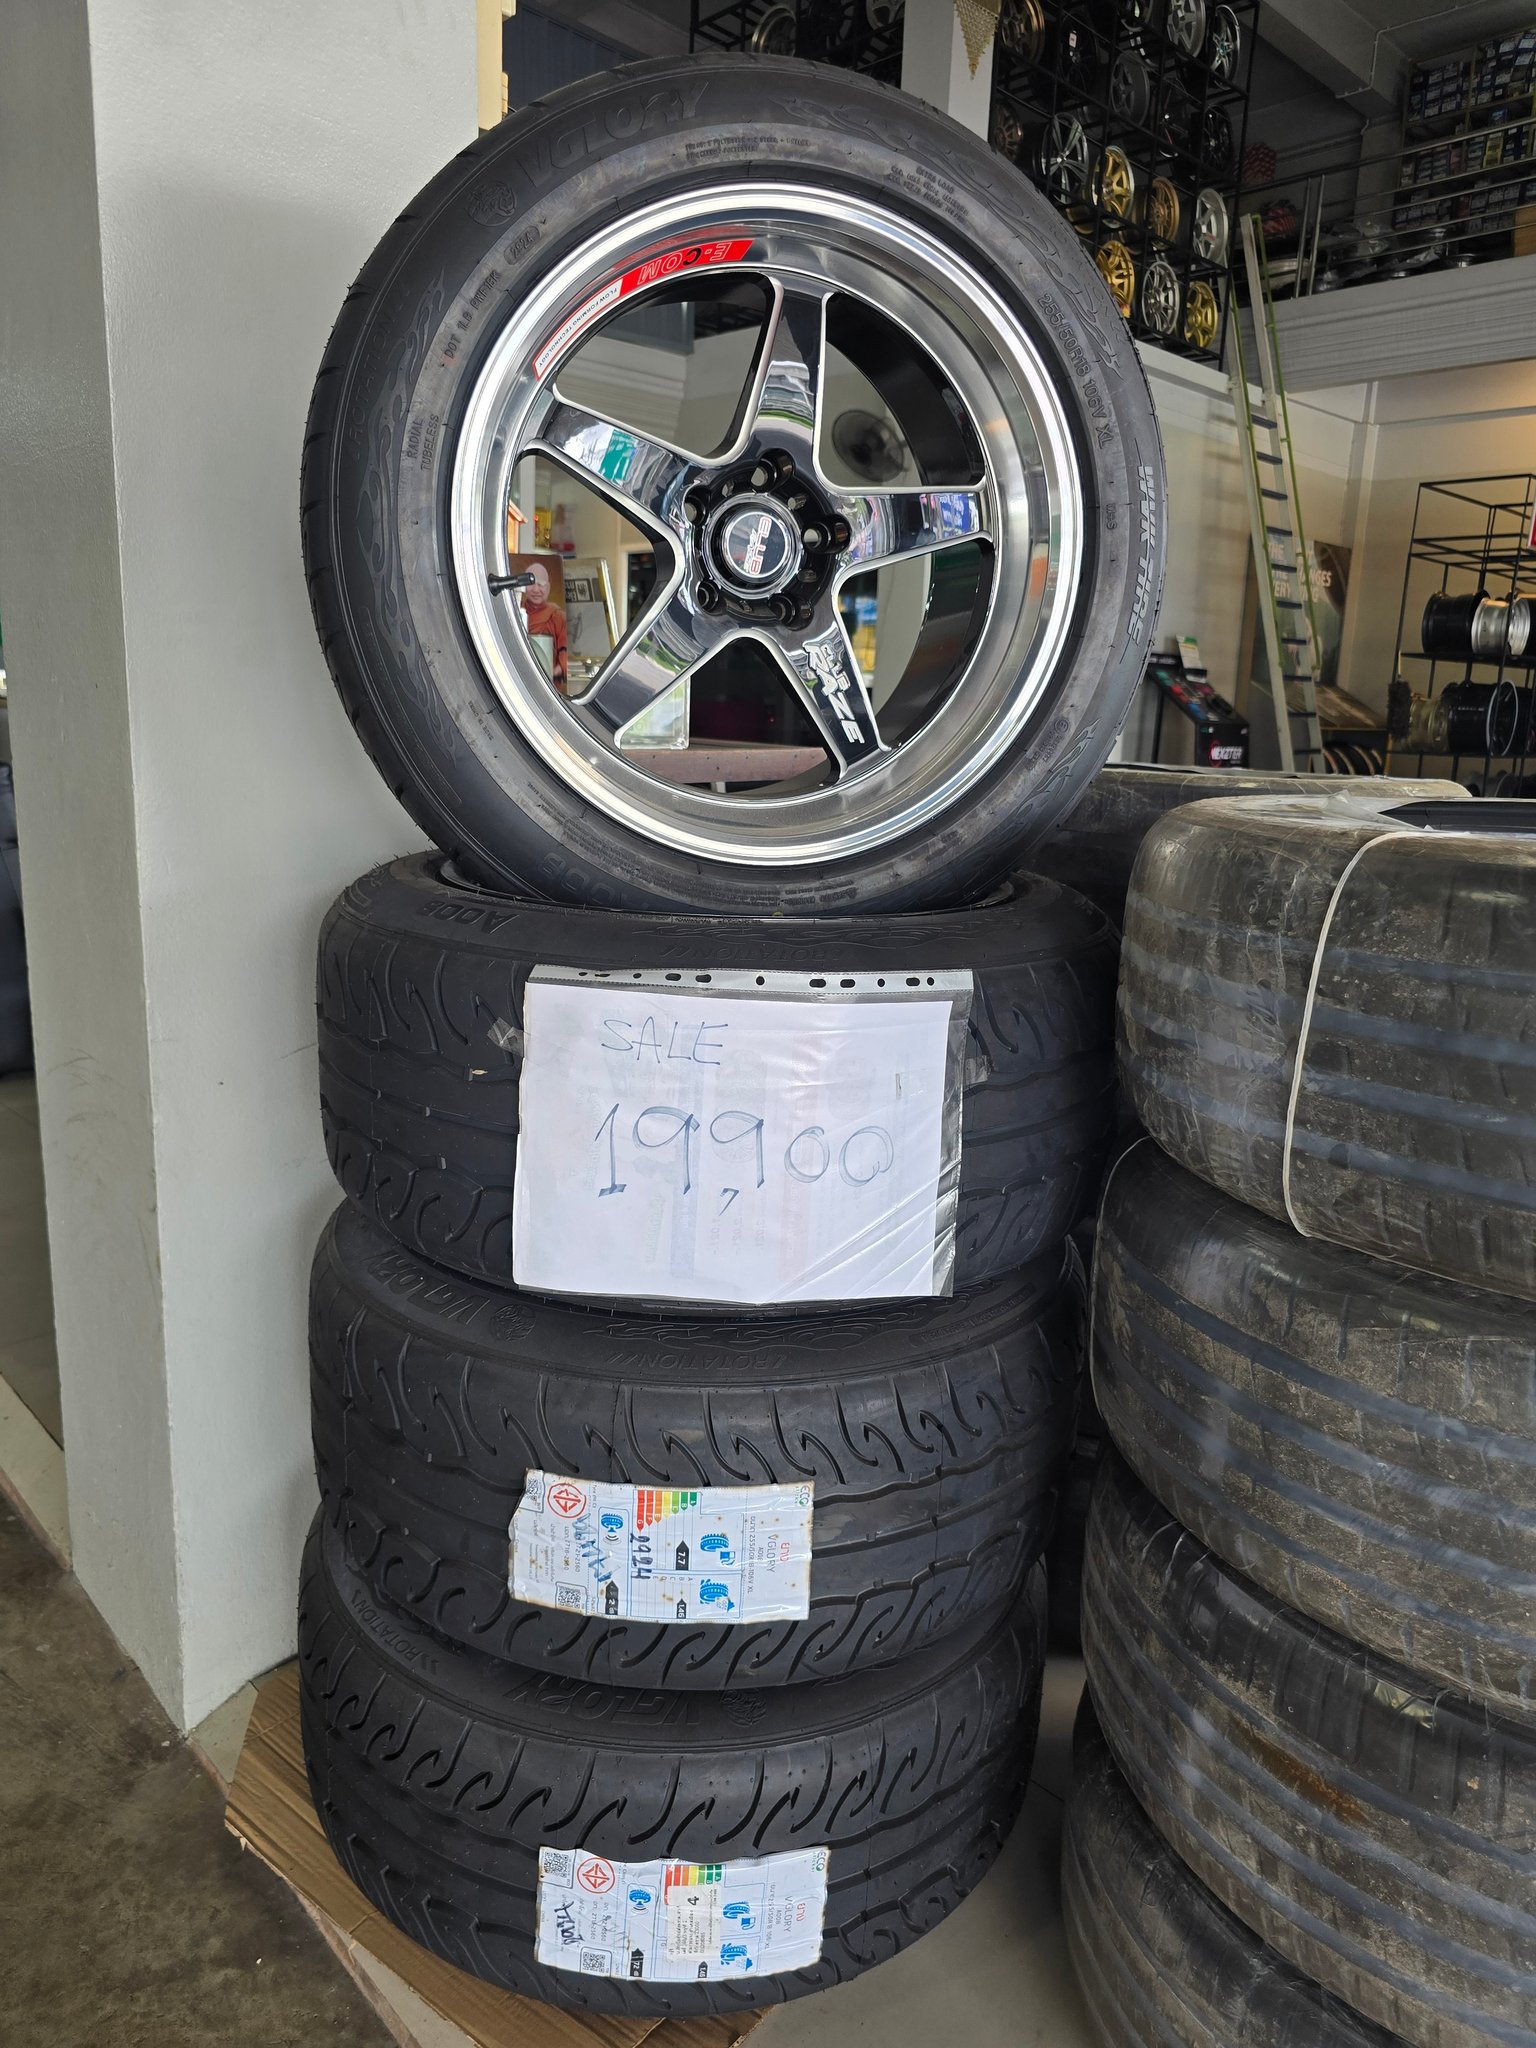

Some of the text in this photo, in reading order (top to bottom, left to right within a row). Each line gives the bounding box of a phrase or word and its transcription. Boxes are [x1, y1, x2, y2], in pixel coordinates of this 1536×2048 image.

[517, 80, 713, 186] VGLORY
[567, 300, 604, 327] FORMING
[536, 325, 573, 368] TECHNOLOGY
[1038, 292, 1117, 449] 255/50R18 106V XL
[406, 417, 425, 458] RADIAL
[419, 413, 440, 472] TUBELESS
[1127, 556, 1154, 646] TIRE
[802, 642, 865, 744] RAZE
[601, 1017, 729, 1066] SALE
[593, 1102, 896, 1216] 19,900
[638, 1353, 770, 1370] ROTATION
[630, 1533, 652, 1580] 2924
[678, 1551, 686, 1565] 7.7
[766, 1534, 776, 1573] VGLORY
[747, 1586, 754, 1594] XL
[352, 1595, 423, 1662] ROTATION
[501, 1671, 704, 1728] VGLORY
[784, 1896, 793, 1932] VGLORY
[796, 1903, 806, 1922] ยาง
